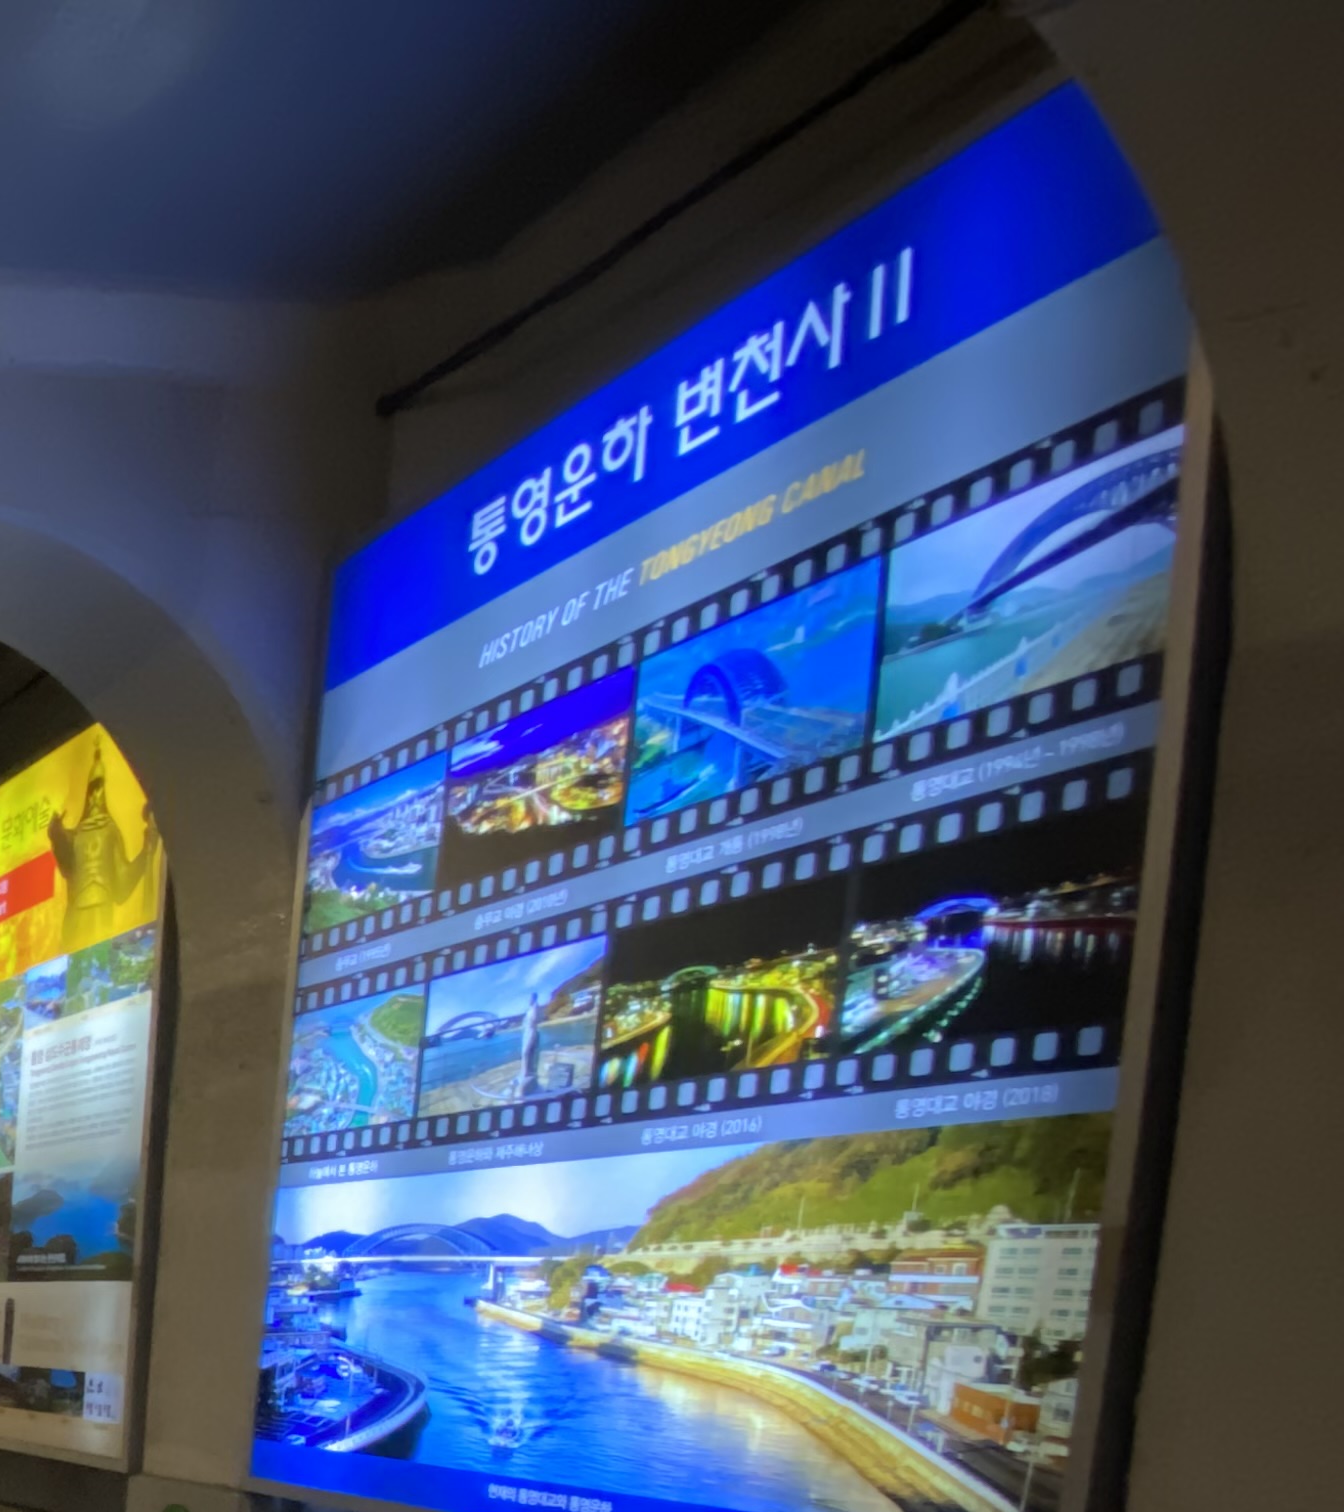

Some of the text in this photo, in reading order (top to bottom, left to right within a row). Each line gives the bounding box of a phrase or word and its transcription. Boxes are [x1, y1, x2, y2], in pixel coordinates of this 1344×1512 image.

[468, 404, 653, 575] 통영운하
[674, 280, 852, 457] 변천사
[479, 448, 865, 668] HISTORY OF THE TONGYEONG CANAL
